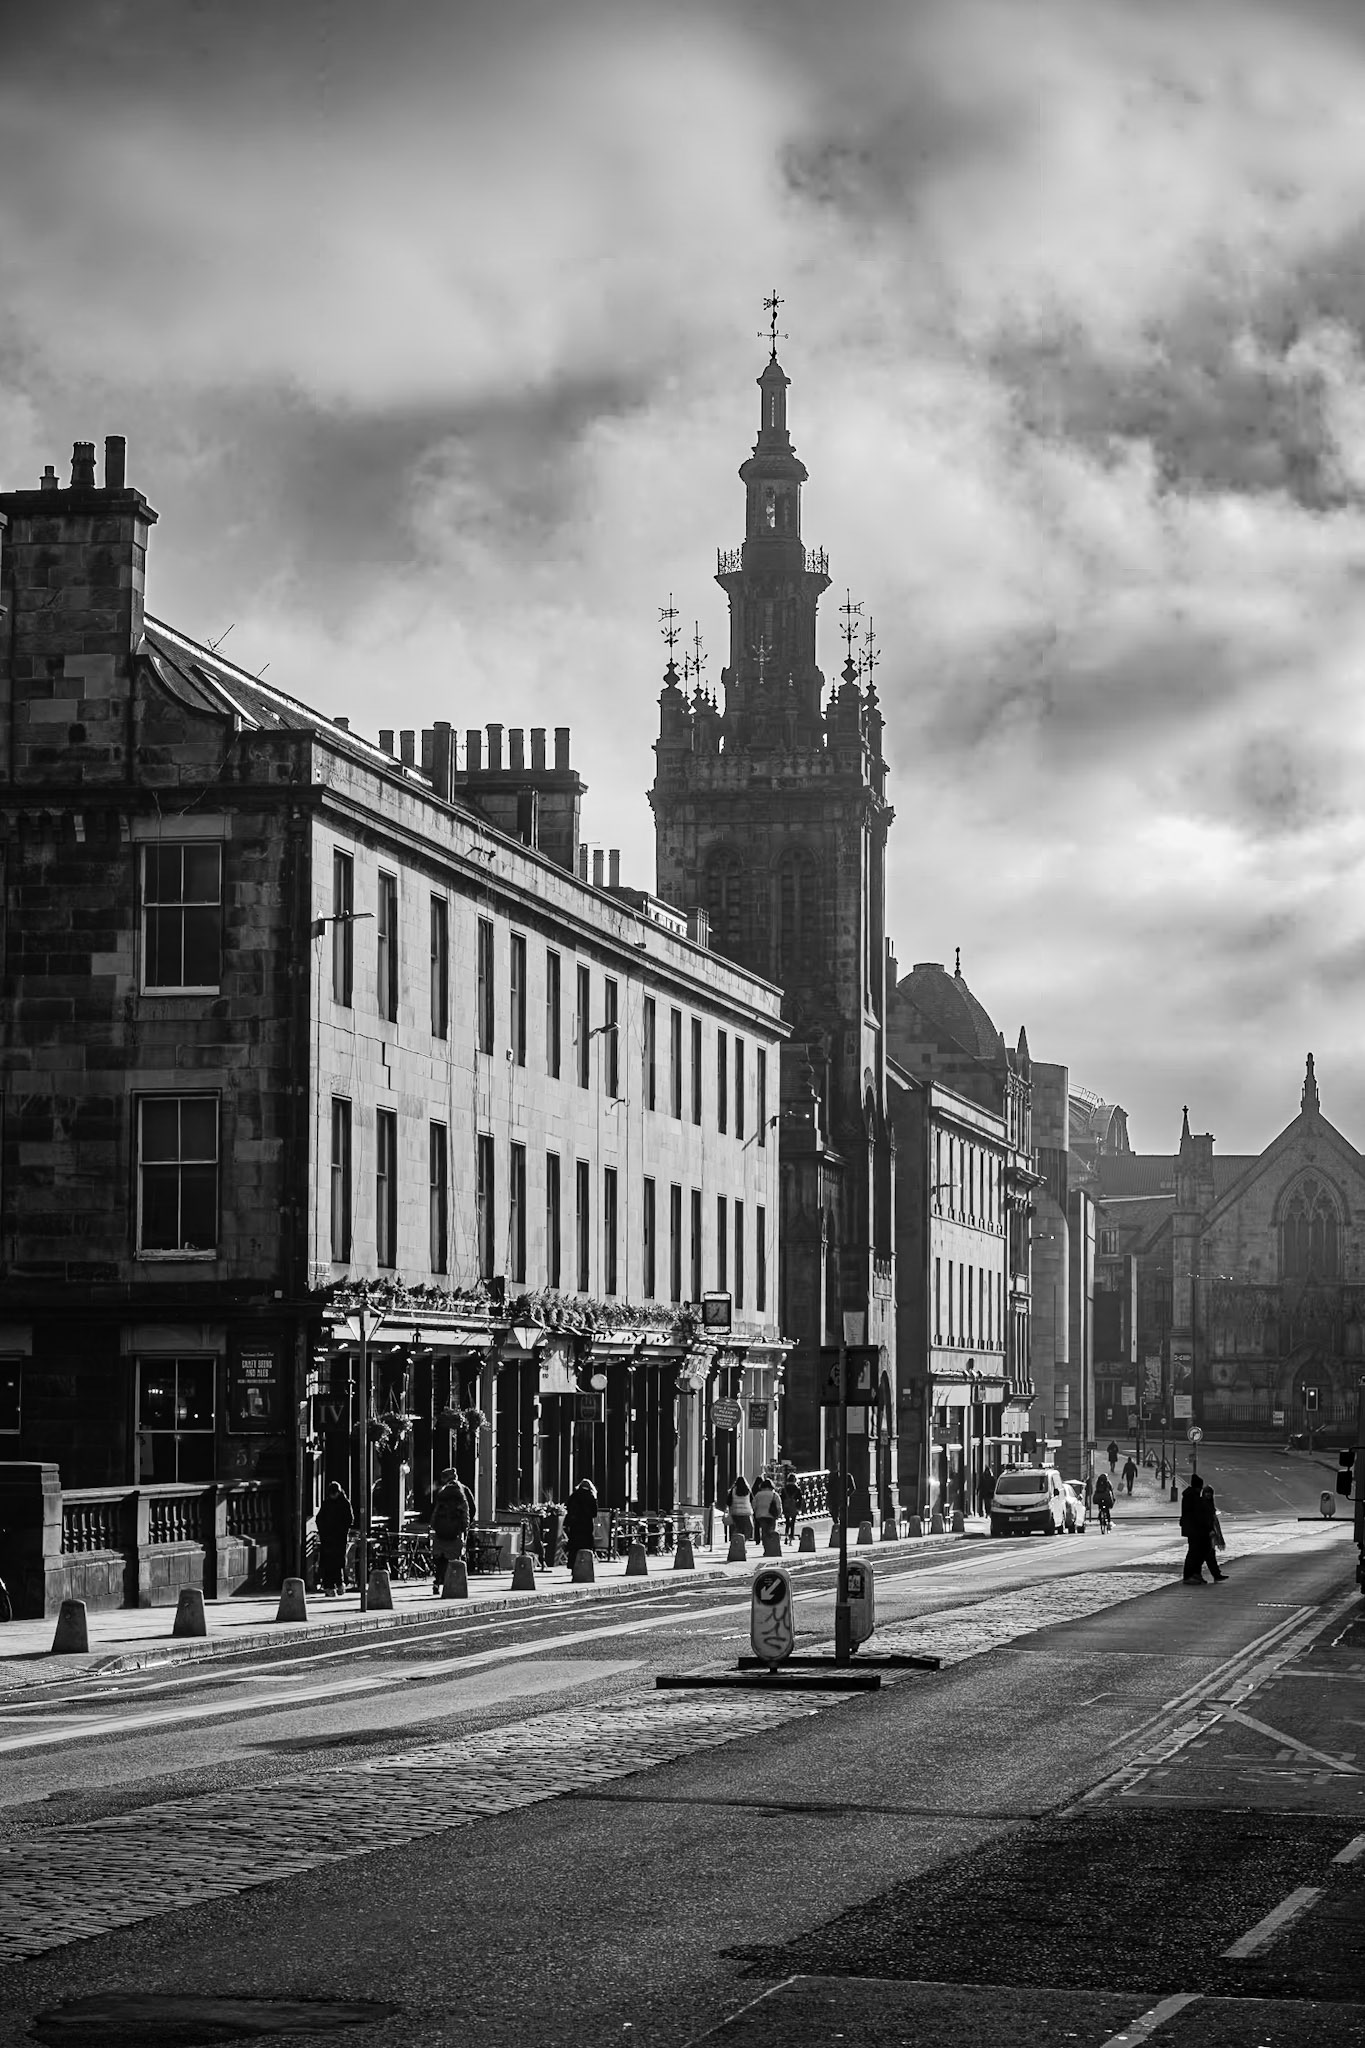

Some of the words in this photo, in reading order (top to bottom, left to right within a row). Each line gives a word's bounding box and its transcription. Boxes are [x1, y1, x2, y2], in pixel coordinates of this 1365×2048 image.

[242, 1360, 256, 1368] CRAFT
[258, 1360, 272, 1368] BEERS
[245, 1369, 256, 1377] AND
[257, 1369, 269, 1377] ALES
[318, 1405, 344, 1423] IV
